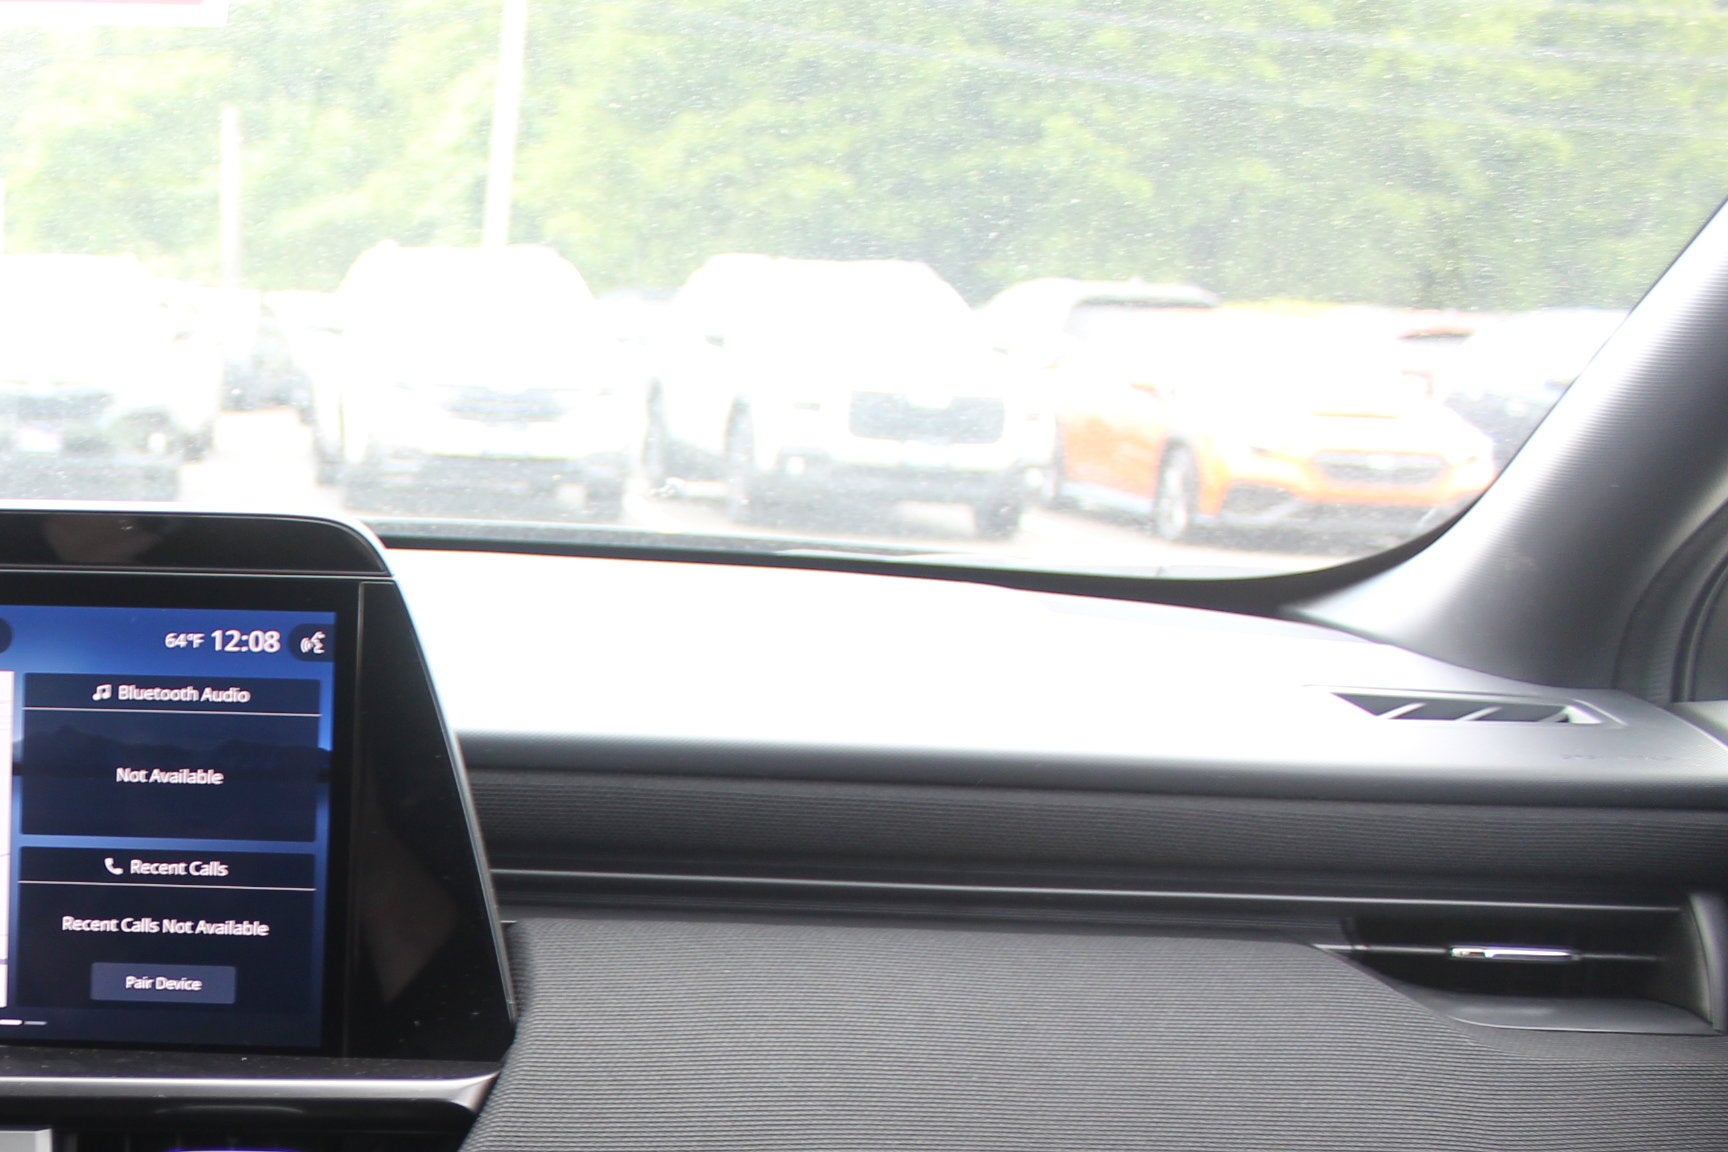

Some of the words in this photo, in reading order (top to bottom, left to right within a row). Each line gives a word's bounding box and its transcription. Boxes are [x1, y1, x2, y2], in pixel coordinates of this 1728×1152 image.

[165, 632, 205, 649] 64°F
[211, 629, 281, 653] 12:08
[118, 684, 199, 702] Bluetooth
[200, 686, 252, 703] Audio
[115, 767, 148, 783] Not
[149, 768, 225, 785] Available
[130, 859, 187, 876] Recent
[189, 861, 229, 877] Calls
[62, 915, 119, 932] Recent
[120, 917, 160, 934] Calls
[162, 919, 194, 934] Not
[194, 920, 270, 936] Available
[125, 975, 154, 990] Pair
[155, 976, 203, 991] Device
